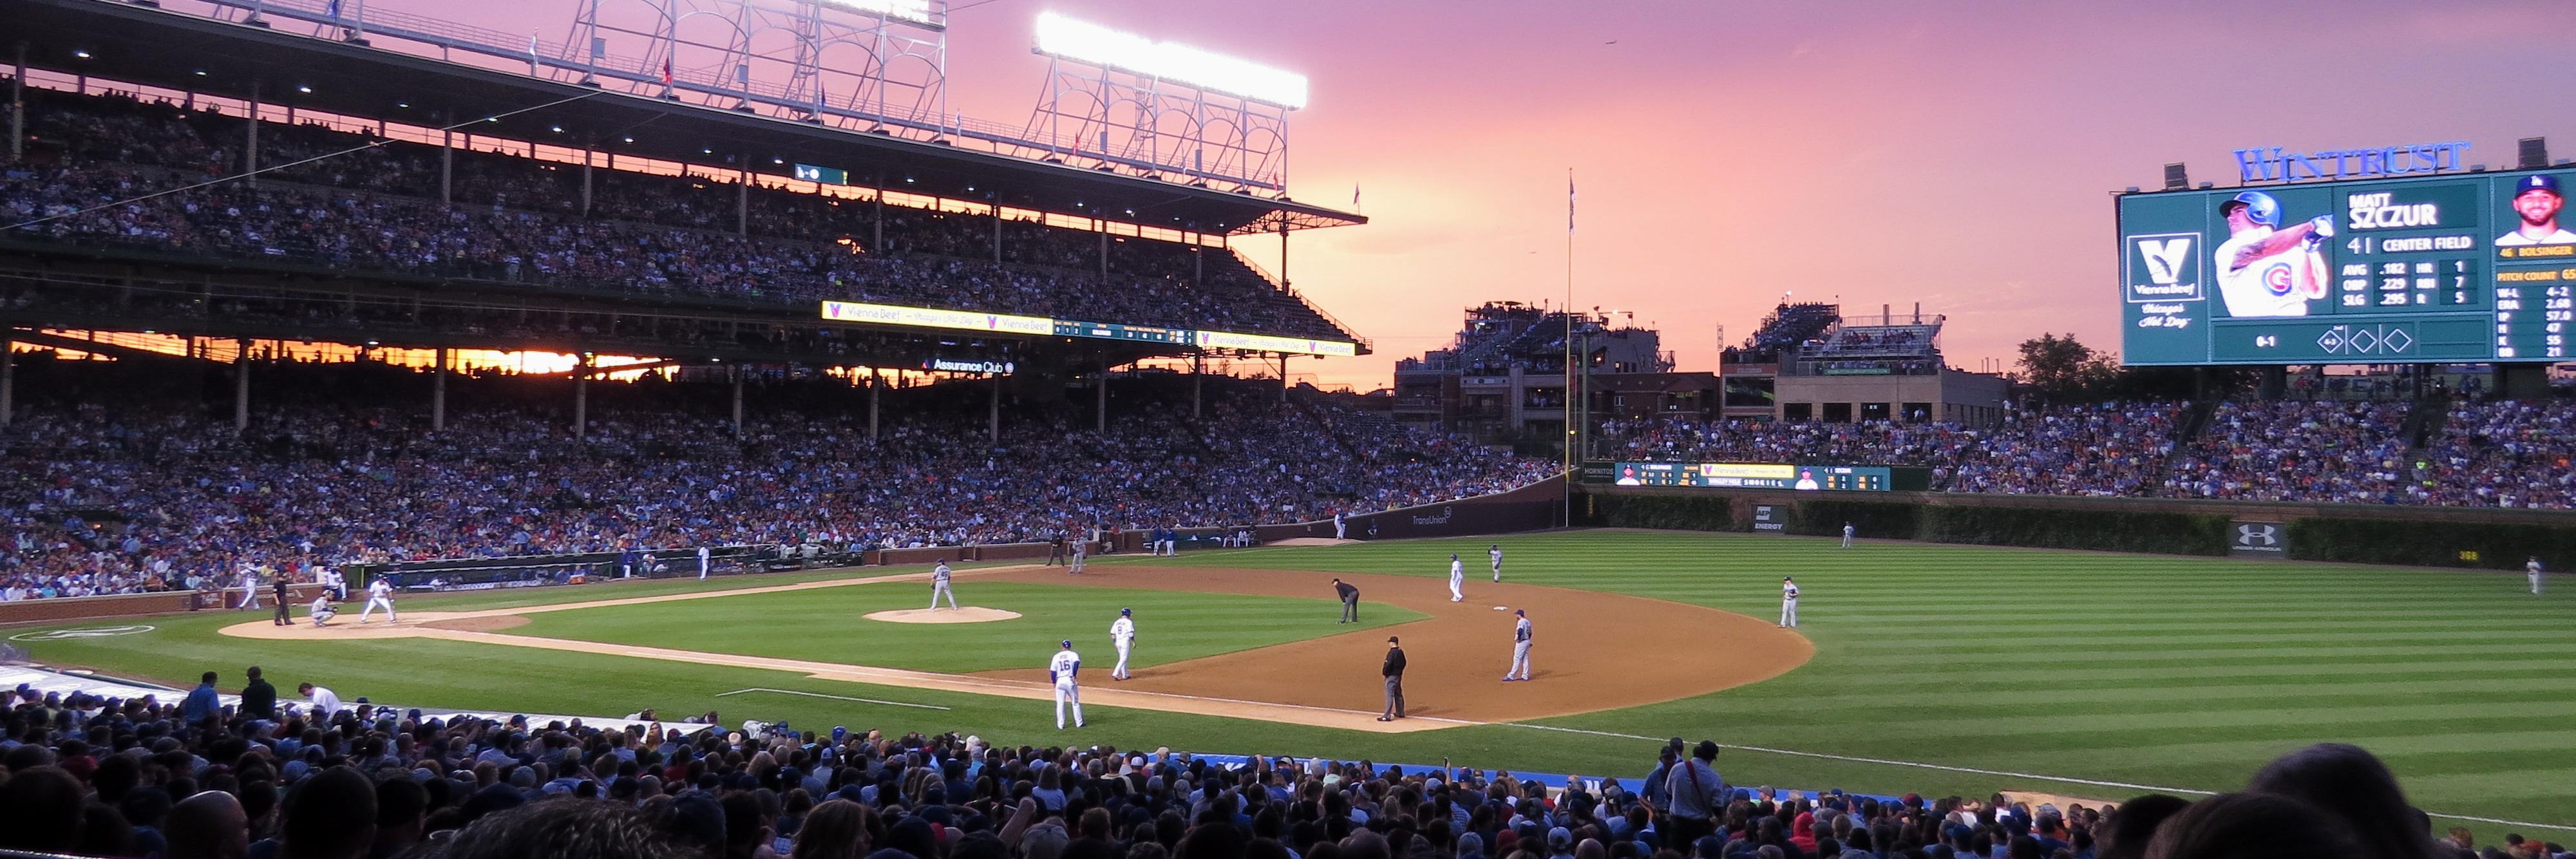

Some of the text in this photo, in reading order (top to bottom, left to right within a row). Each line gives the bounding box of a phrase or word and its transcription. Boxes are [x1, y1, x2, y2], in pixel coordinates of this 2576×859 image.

[2232, 141, 2470, 182] WINTRUST
[2349, 193, 2391, 208] MATT
[2349, 204, 2438, 229] SZCZUR
[2347, 236, 2371, 254] 41
[2382, 236, 2472, 252] CENTER FIELD
[2499, 246, 2574, 258] 46 BOLSINGER
[2342, 263, 2405, 276] AVG .182
[2416, 261, 2464, 274] HR 1
[2497, 269, 2576, 282] PITCH COUNT 65
[2342, 279, 2367, 291] OBP
[2455, 276, 2464, 288] 7
[2416, 292, 2464, 304] R 5
[2497, 287, 2568, 298] W-L 4-2
[2343, 292, 2407, 307] SLG .295
[2497, 300, 2519, 310] ERA
[848, 307, 878, 318] Vienna
[880, 308, 900, 322] Beef
[1002, 319, 1029, 329] Vienna
[1030, 321, 1047, 332] Beef
[2497, 312, 2510, 322] IP
[2498, 323, 2561, 334] H 47
[1213, 335, 1235, 344] Vienna
[1320, 343, 1338, 352] Vienna
[2256, 335, 2275, 347] 0-1
[2498, 335, 2561, 346] K 55
[2546, 346, 2561, 357] 21
[934, 359, 982, 372] Assurance
[983, 361, 1003, 373] Club
[1412, 515, 1447, 525] TransUnion
[1117, 626, 1122, 635] 8
[1058, 660, 1071, 672] 16
